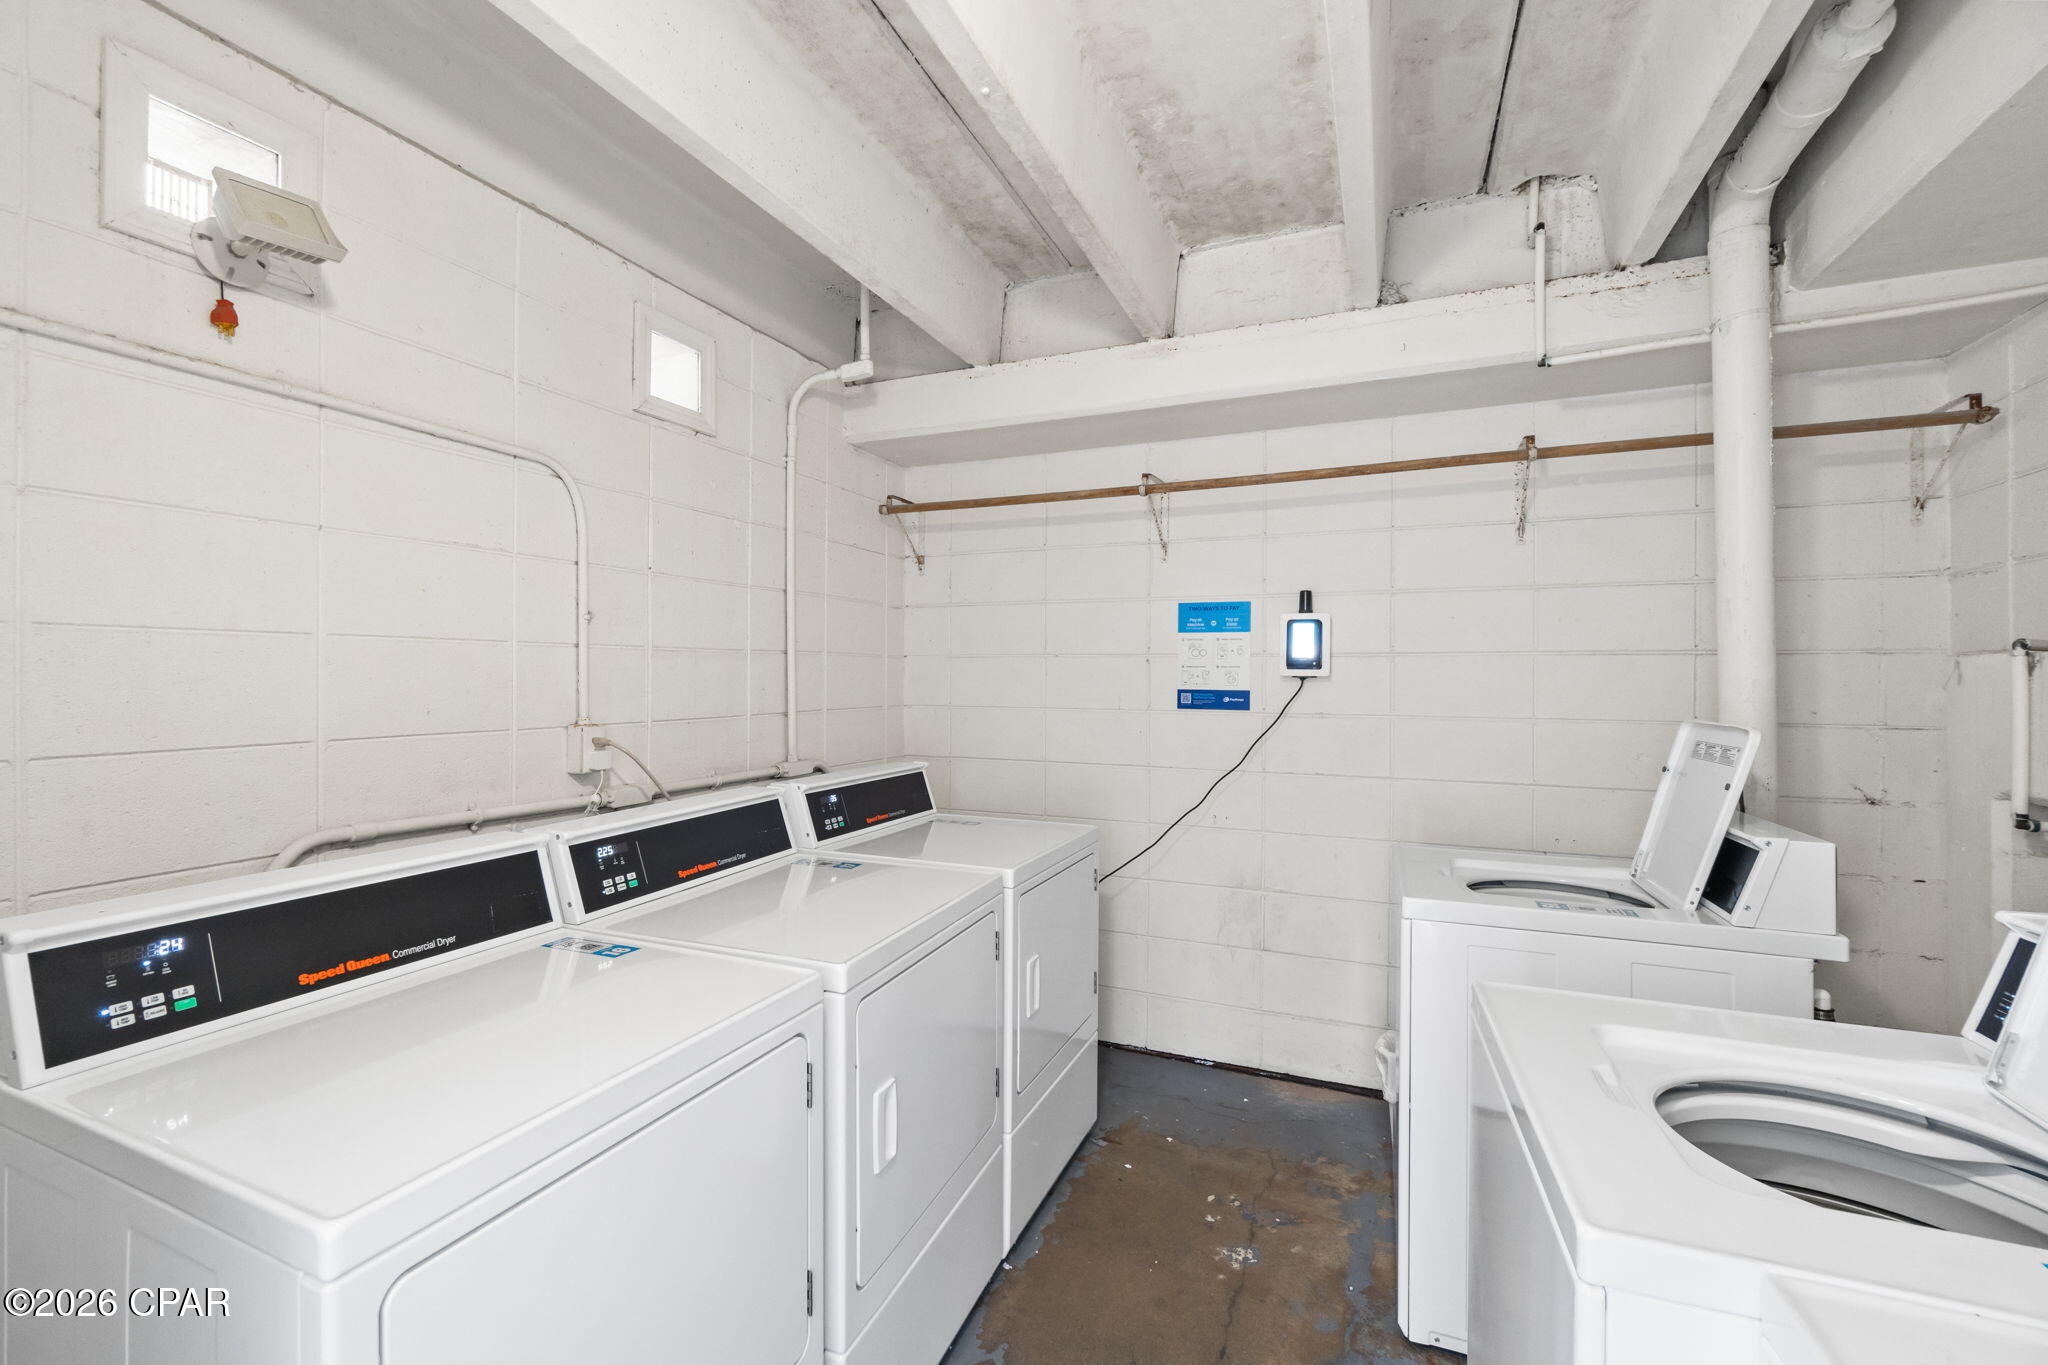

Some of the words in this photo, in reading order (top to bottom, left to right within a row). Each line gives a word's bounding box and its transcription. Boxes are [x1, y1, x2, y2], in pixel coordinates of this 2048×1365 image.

[678, 866, 698, 878] Speed
[298, 963, 345, 985] Speed
[346, 953, 390, 972] Queen
[392, 940, 436, 959] Commercial
[436, 935, 457, 947] Dryer
